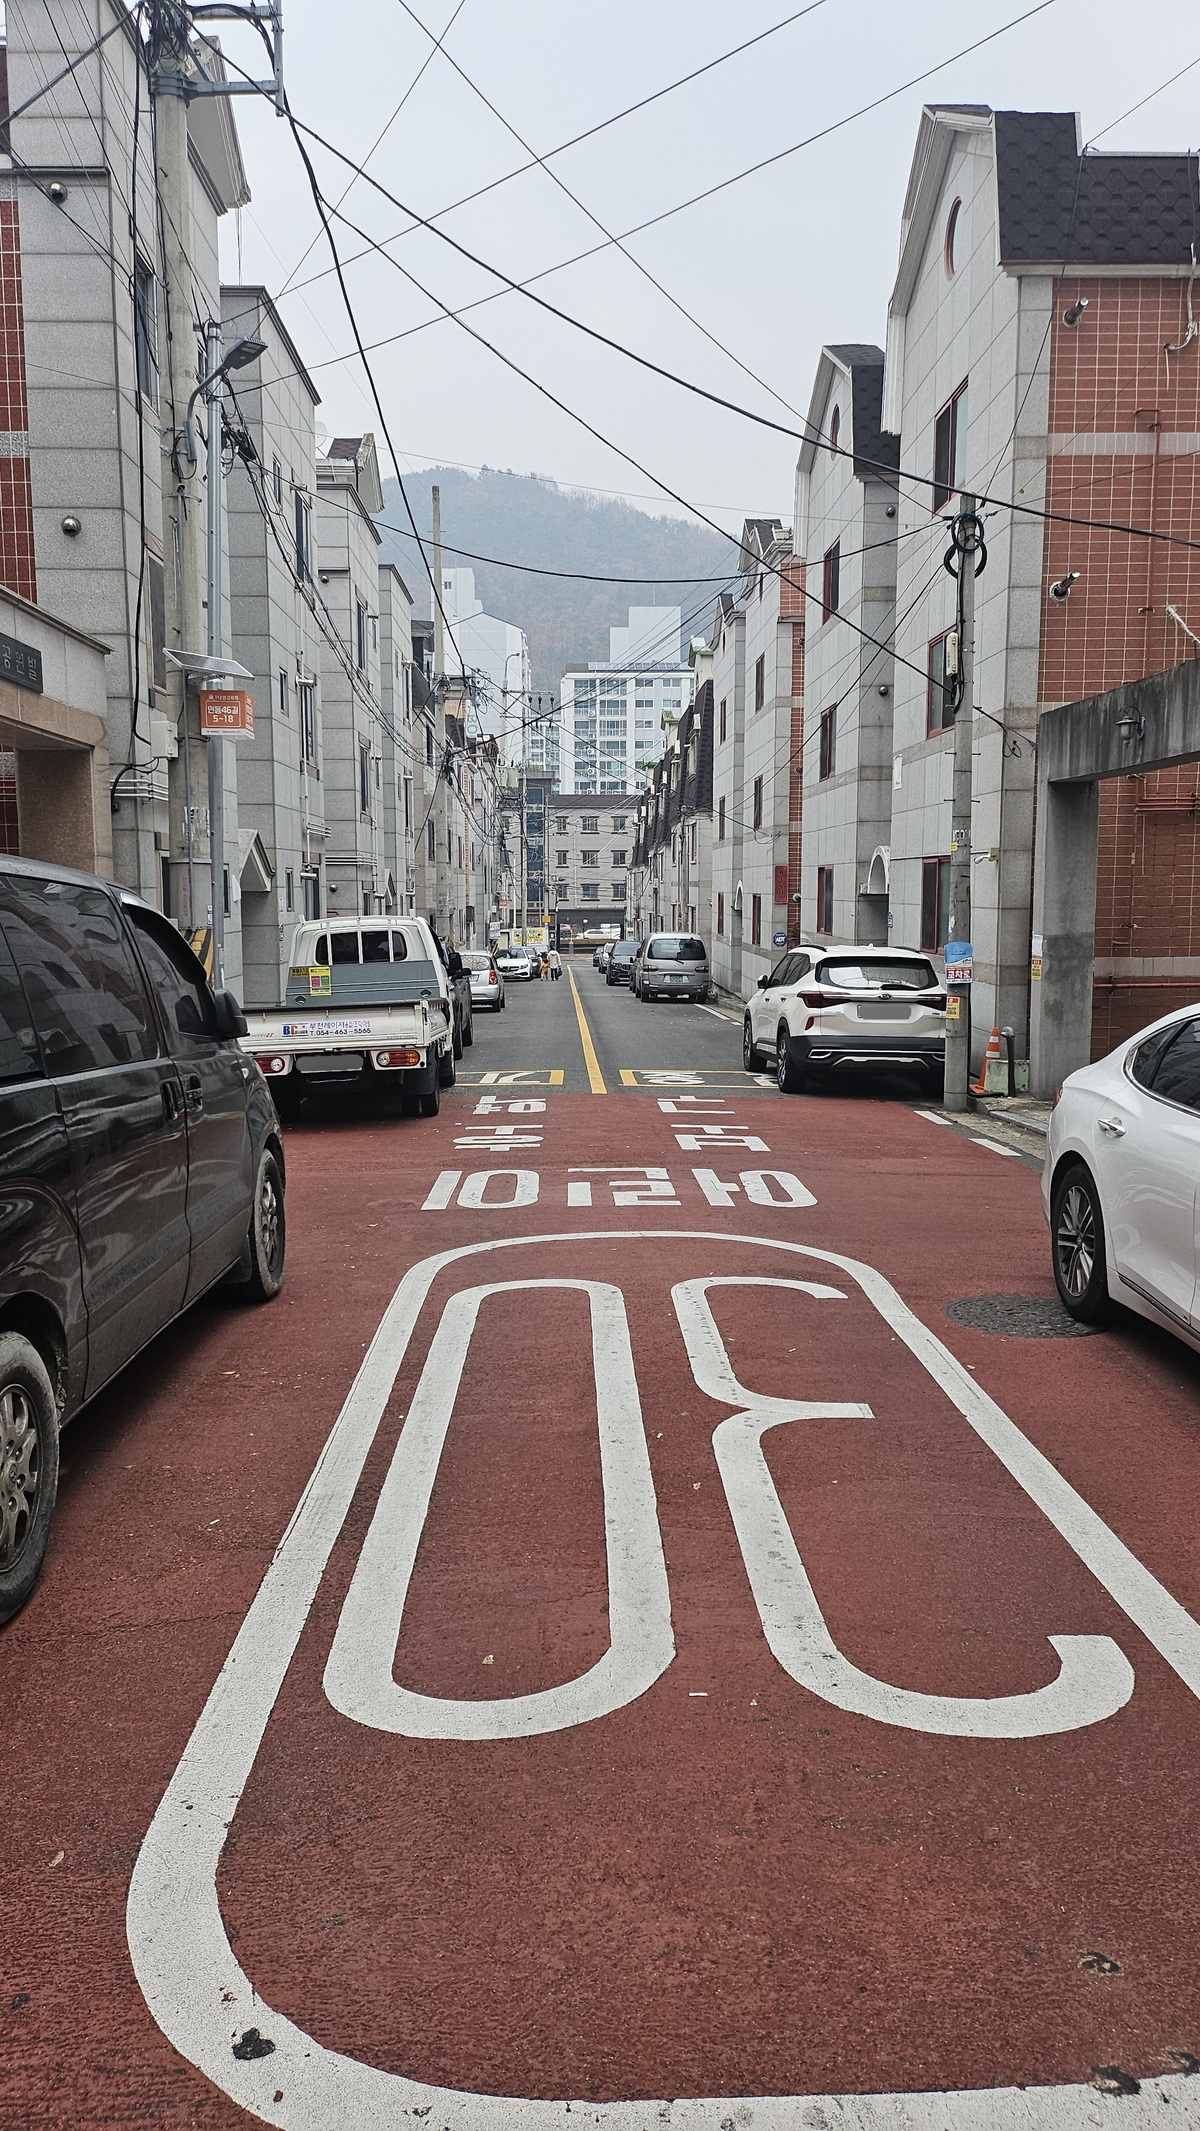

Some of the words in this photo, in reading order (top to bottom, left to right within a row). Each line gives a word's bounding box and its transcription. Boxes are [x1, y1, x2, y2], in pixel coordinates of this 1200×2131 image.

[2, 644, 37, 681] 공원빌
[208, 705, 238, 714] 인동46길
[213, 714, 234, 722] 5-18
[948, 970, 970, 978] 교차로
[283, 1026, 298, 1035] BC
[310, 1028, 372, 1036] T.054-463-5565
[452, 1124, 772, 1152] 보호
[421, 1168, 818, 1210] 어린이
[323, 1276, 1135, 1740] 30
